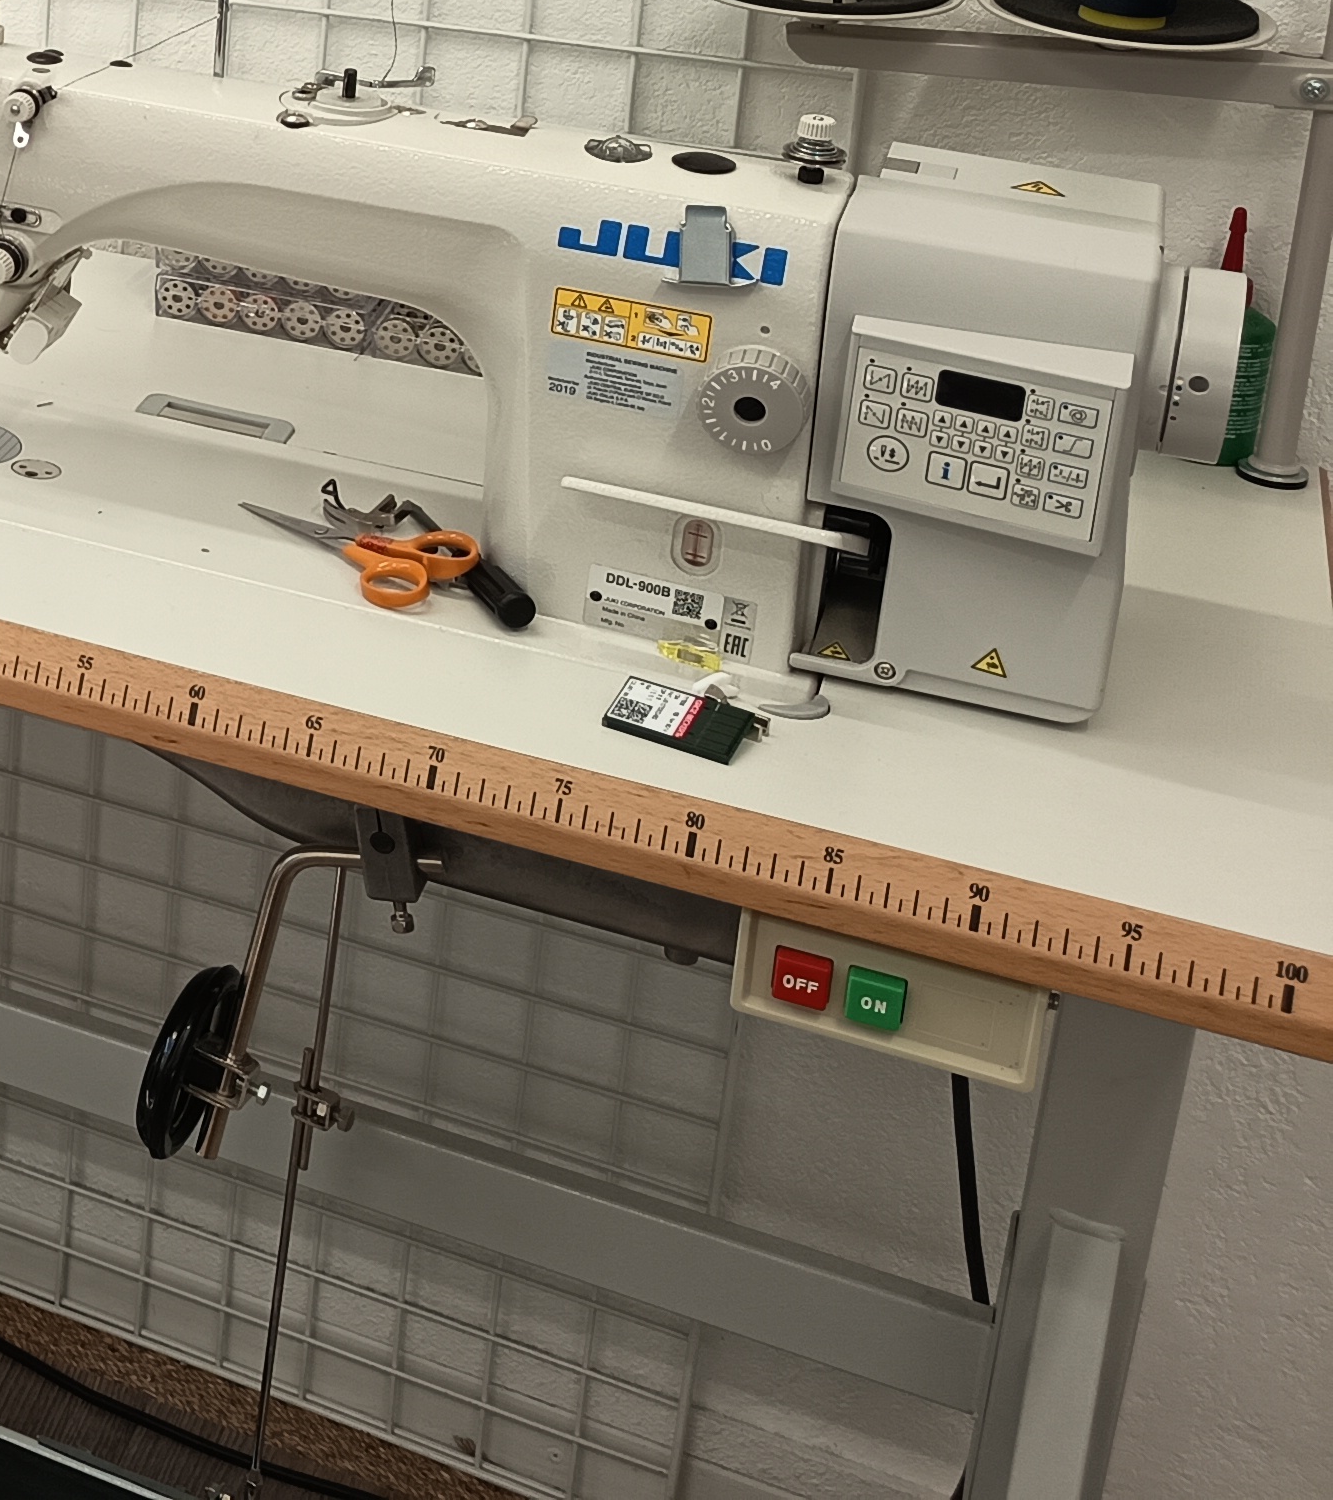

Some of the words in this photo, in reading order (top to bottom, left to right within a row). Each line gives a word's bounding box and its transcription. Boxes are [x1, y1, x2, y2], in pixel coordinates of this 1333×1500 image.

[728, 369, 738, 383] 3
[548, 381, 577, 396] 2019
[770, 378, 779, 391] 4
[701, 396, 715, 409] 2
[760, 439, 771, 451] 0
[605, 572, 671, 598] DDL-900B
[77, 654, 94, 670] 55
[189, 684, 205, 700] 60
[305, 715, 323, 731] 65
[428, 746, 445, 763] 70
[555, 778, 573, 795] 75
[685, 811, 705, 830] 80
[823, 846, 845, 864] 85
[969, 883, 990, 902] 90
[1121, 921, 1143, 941] 95
[1276, 961, 1309, 983] 100
[782, 973, 819, 994] OFF
[861, 996, 886, 1015] ON
